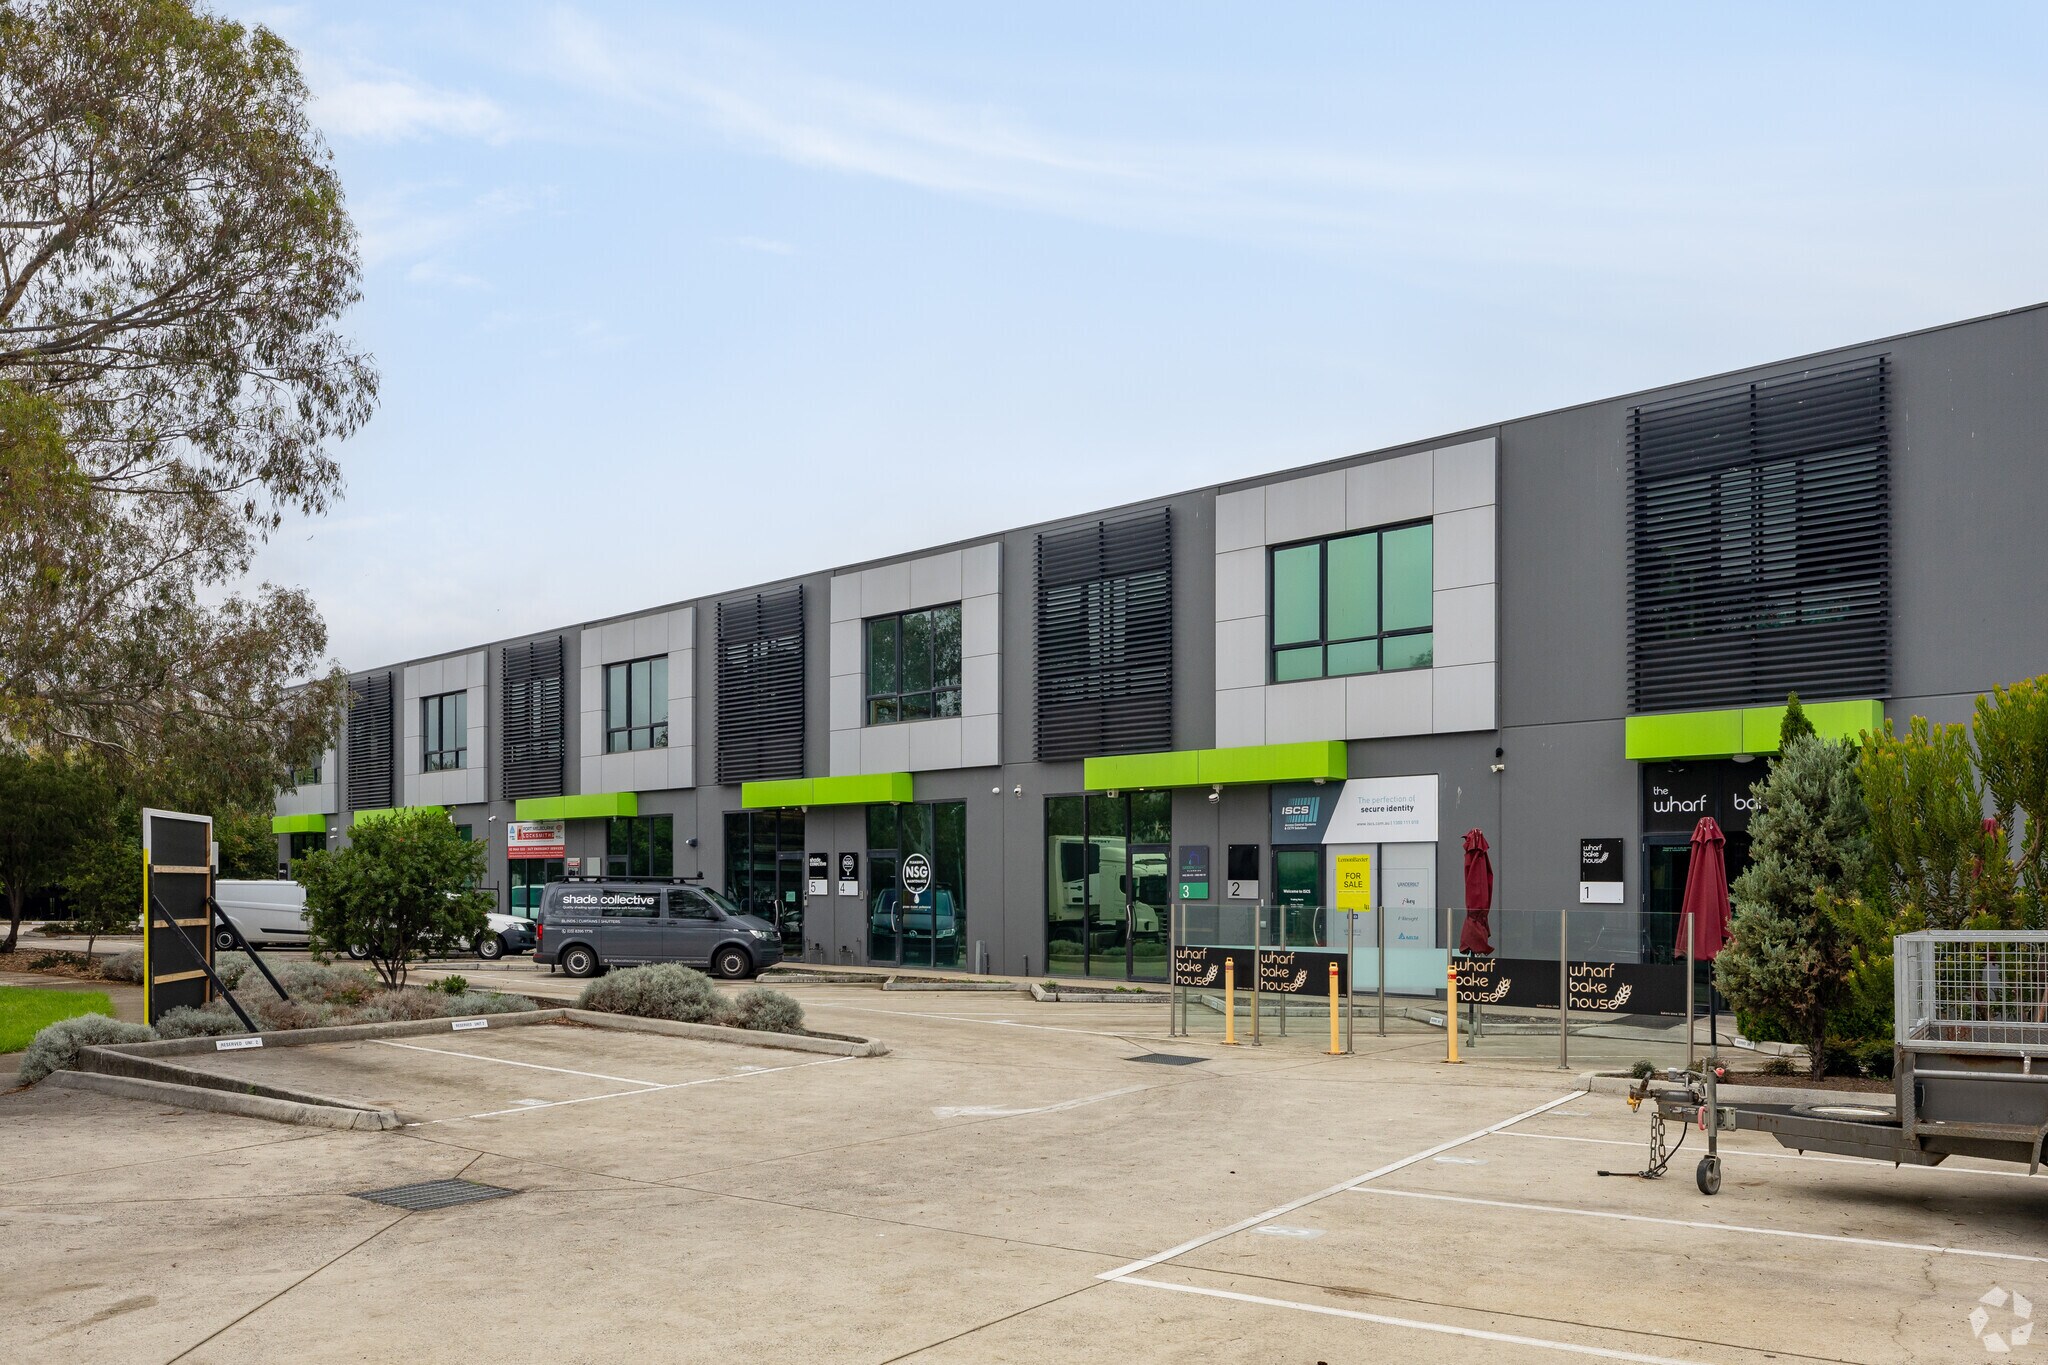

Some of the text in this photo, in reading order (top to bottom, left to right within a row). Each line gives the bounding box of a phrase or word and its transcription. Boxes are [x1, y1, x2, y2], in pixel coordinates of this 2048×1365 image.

[1653, 786, 1669, 795] the
[1357, 794, 1416, 805] The perfection of
[1653, 794, 1707, 813] wharf
[1281, 805, 1309, 815] ISCS
[1386, 804, 1415, 813] identity
[905, 865, 928, 878] NSG
[810, 881, 817, 893] 5
[839, 882, 846, 894] 4
[1231, 881, 1240, 897] 2
[1343, 880, 1363, 888] SALE
[1182, 884, 1190, 898] 3
[1584, 886, 1589, 899] 1
[562, 894, 655, 905] shade collective
[1176, 947, 1207, 960] wharf
[1260, 950, 1295, 965] wharf
[1176, 960, 1202, 972] bake
[1260, 964, 1289, 978] bake
[1454, 957, 1496, 972] wharf
[1569, 962, 1615, 978] wharf
[1176, 972, 1210, 986] house
[1260, 977, 1298, 992] house
[1569, 977, 1607, 993] bake
[1569, 993, 1619, 1010] house
